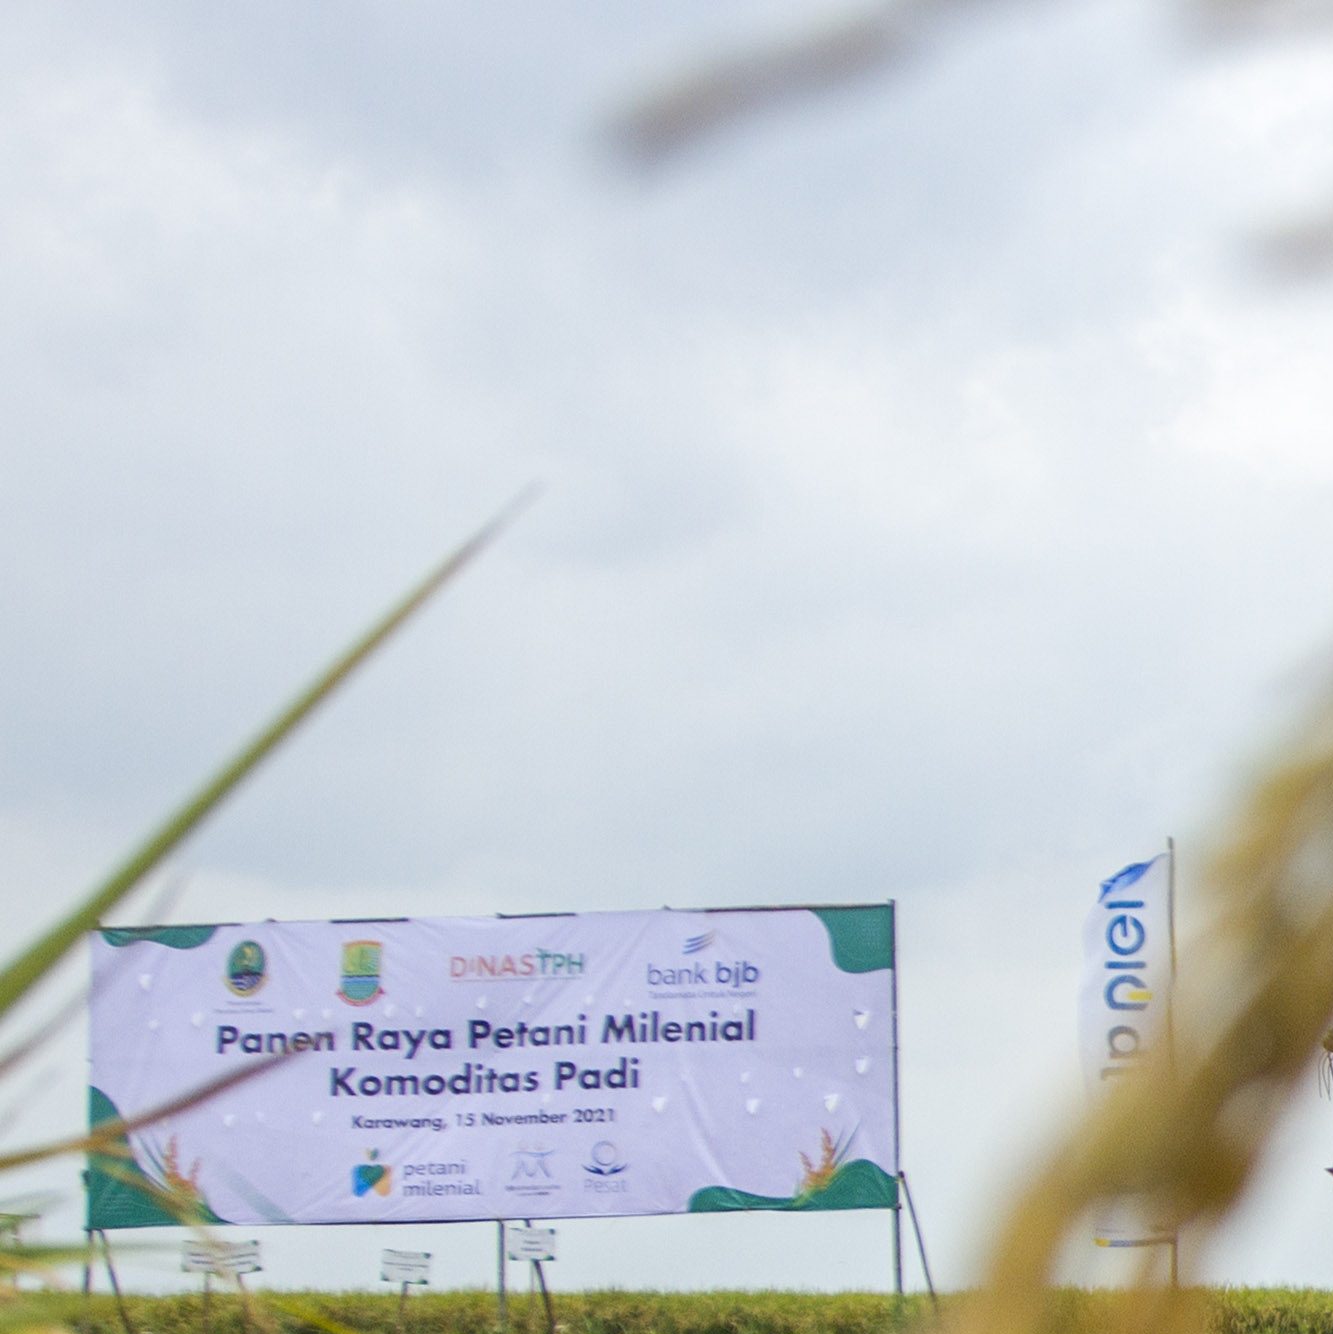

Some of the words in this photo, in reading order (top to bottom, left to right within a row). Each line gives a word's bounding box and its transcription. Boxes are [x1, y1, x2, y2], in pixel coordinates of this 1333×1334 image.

[647, 962, 708, 986] bank
[715, 960, 760, 988] bjb
[216, 1025, 335, 1054] Panen
[351, 1021, 453, 1059] Raya
[467, 1013, 587, 1049] Petani
[600, 1008, 756, 1044] Milenial
[329, 1062, 540, 1097] Komoditas
[553, 1056, 639, 1091] Padi
[351, 1114, 447, 1132] Karawang,
[455, 1112, 475, 1127] 15
[481, 1110, 568, 1127] November
[573, 1107, 616, 1123] 2021
[403, 1160, 467, 1178] petani
[402, 1180, 482, 1198] milenial
